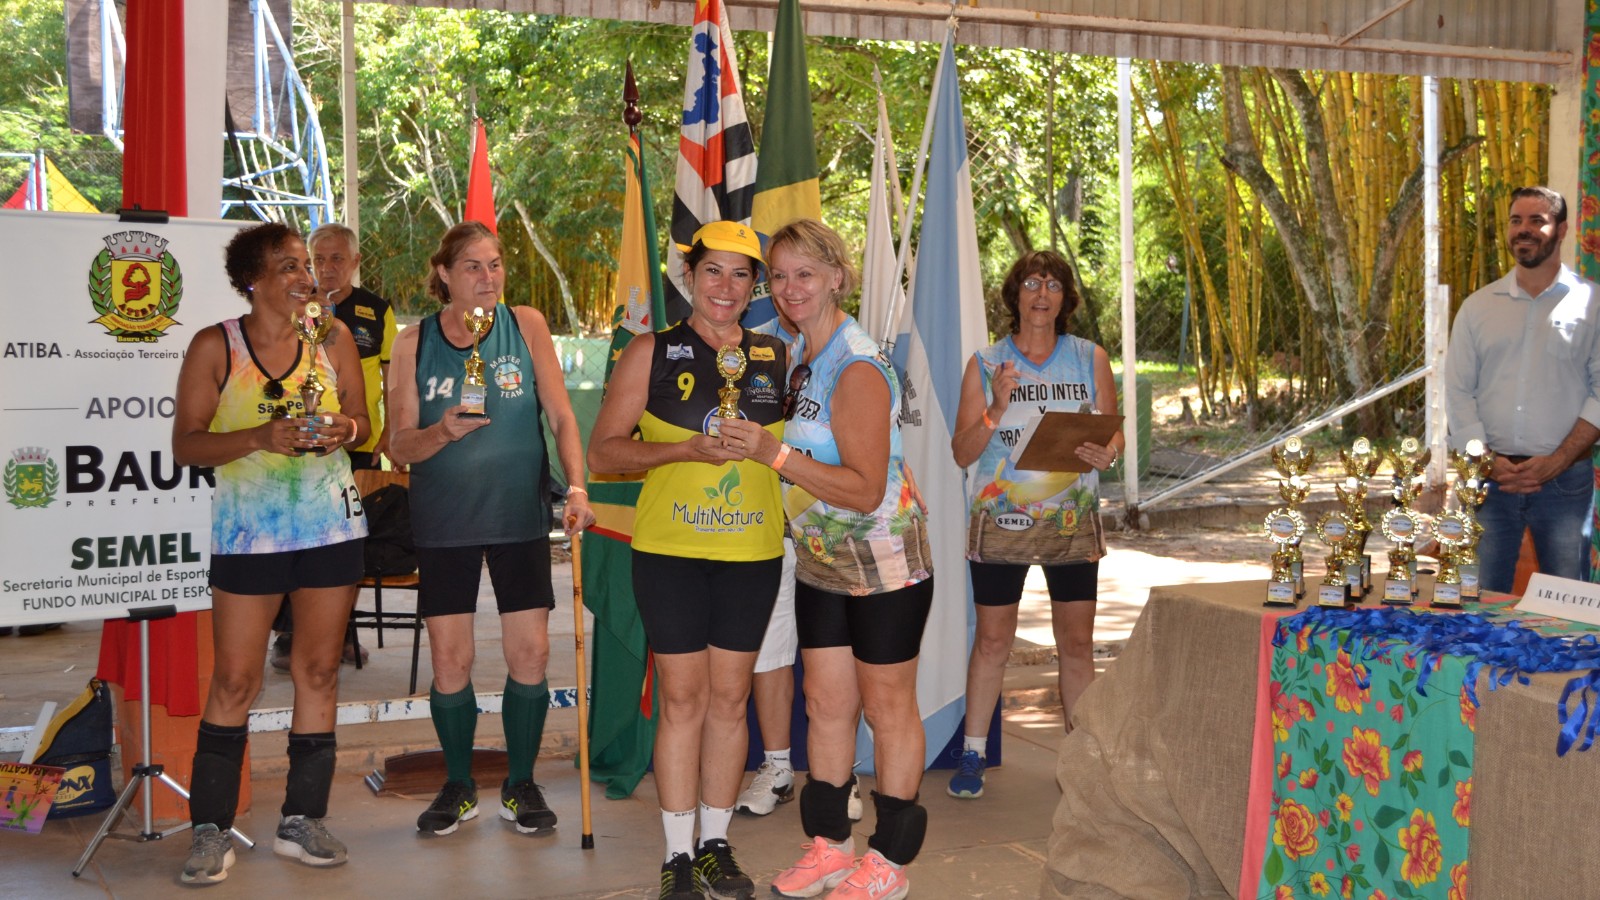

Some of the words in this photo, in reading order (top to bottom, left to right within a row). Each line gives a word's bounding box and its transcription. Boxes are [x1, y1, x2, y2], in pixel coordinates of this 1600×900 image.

[118, 303, 156, 317] ATIBA
[4, 342, 63, 358] ATIBA
[74, 349, 135, 361] Associação
[138, 349, 179, 359] Terceira
[490, 354, 521, 370] MASTER
[500, 389, 524, 399] TEAM
[677, 372, 695, 401] 9
[1052, 383, 1089, 401] INTER
[85, 396, 176, 419] APOIO
[999, 427, 1024, 447] PRA
[341, 484, 363, 520] 13
[672, 501, 764, 526] MultiNature
[997, 517, 1032, 527] SEMEL
[71, 532, 201, 570] SEMEL
[3, 575, 73, 592] Secretaria
[77, 571, 142, 588] Municipal
[147, 570, 162, 582] de
[23, 595, 76, 610] FUNDO
[81, 589, 157, 606] MUNICIPAL
[162, 587, 178, 600] DE
[866, 871, 898, 898] FILA
